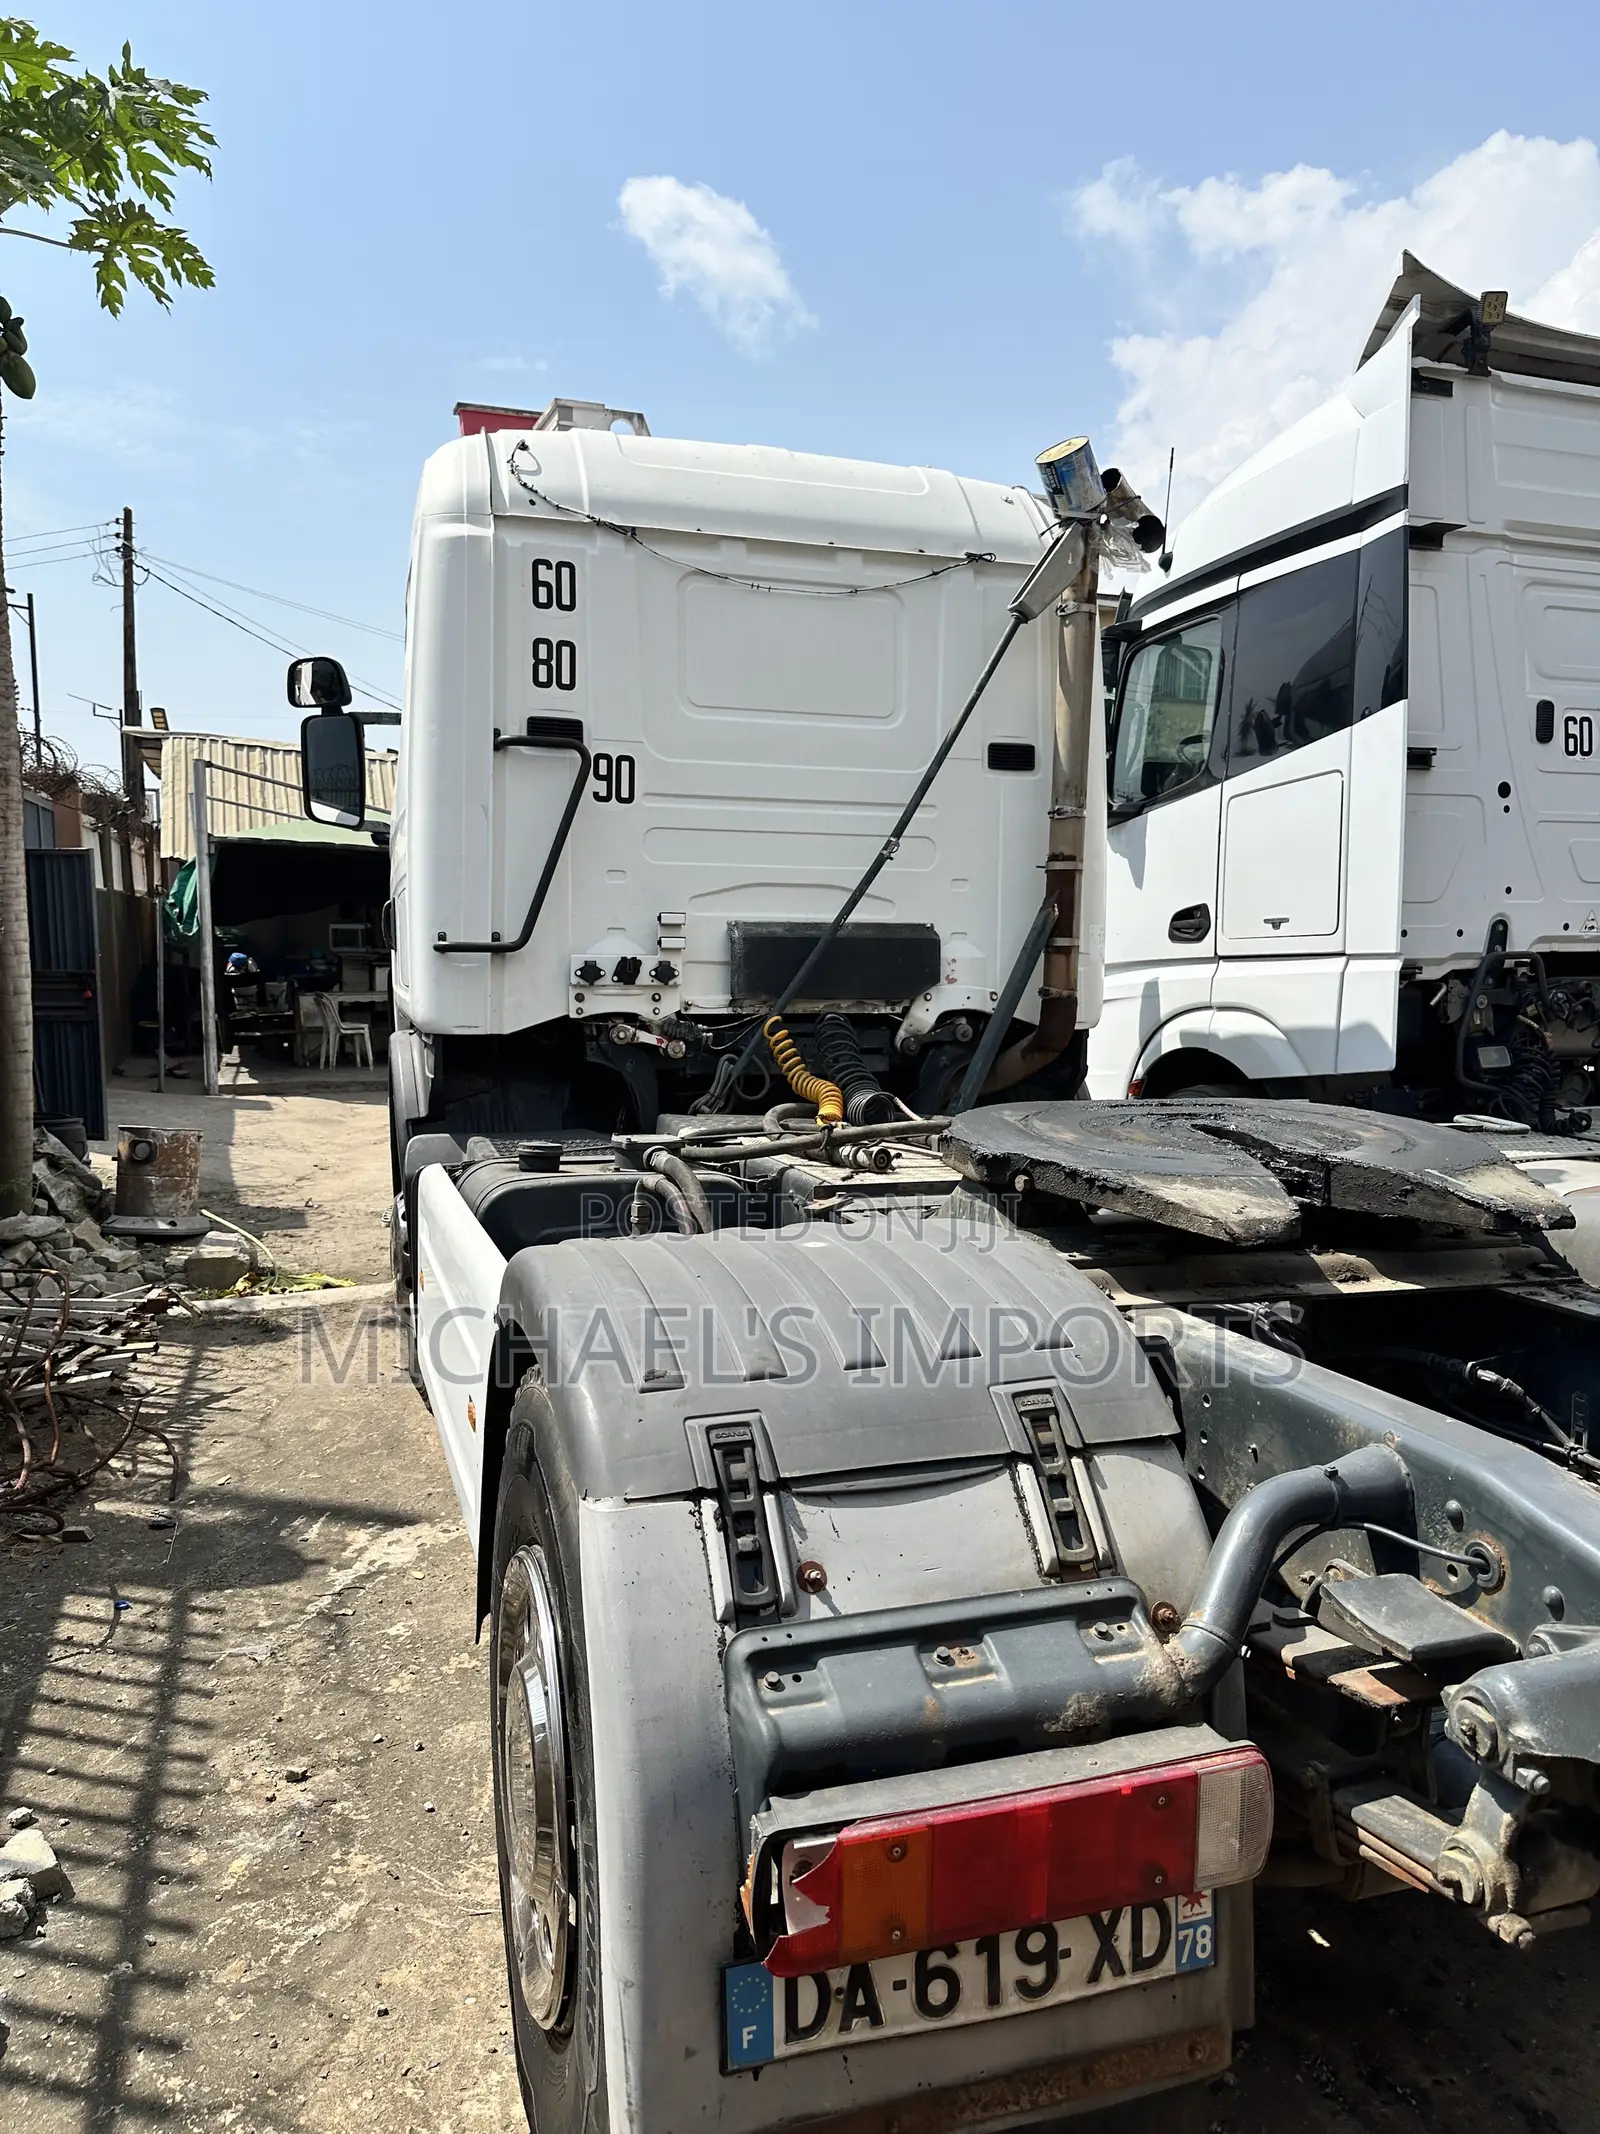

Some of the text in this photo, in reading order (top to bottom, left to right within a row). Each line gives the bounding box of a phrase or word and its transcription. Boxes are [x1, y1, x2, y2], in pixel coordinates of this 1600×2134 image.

[531, 558, 576, 612] 60
[531, 638, 576, 690] 80
[1564, 715, 1593, 757] 60
[592, 753, 635, 804] 90
[714, 1430, 749, 1440] SCANIA
[1178, 1924, 1212, 1964] 78
[783, 1898, 1173, 2045] DA-619-XD
[741, 2025, 757, 2049] F
